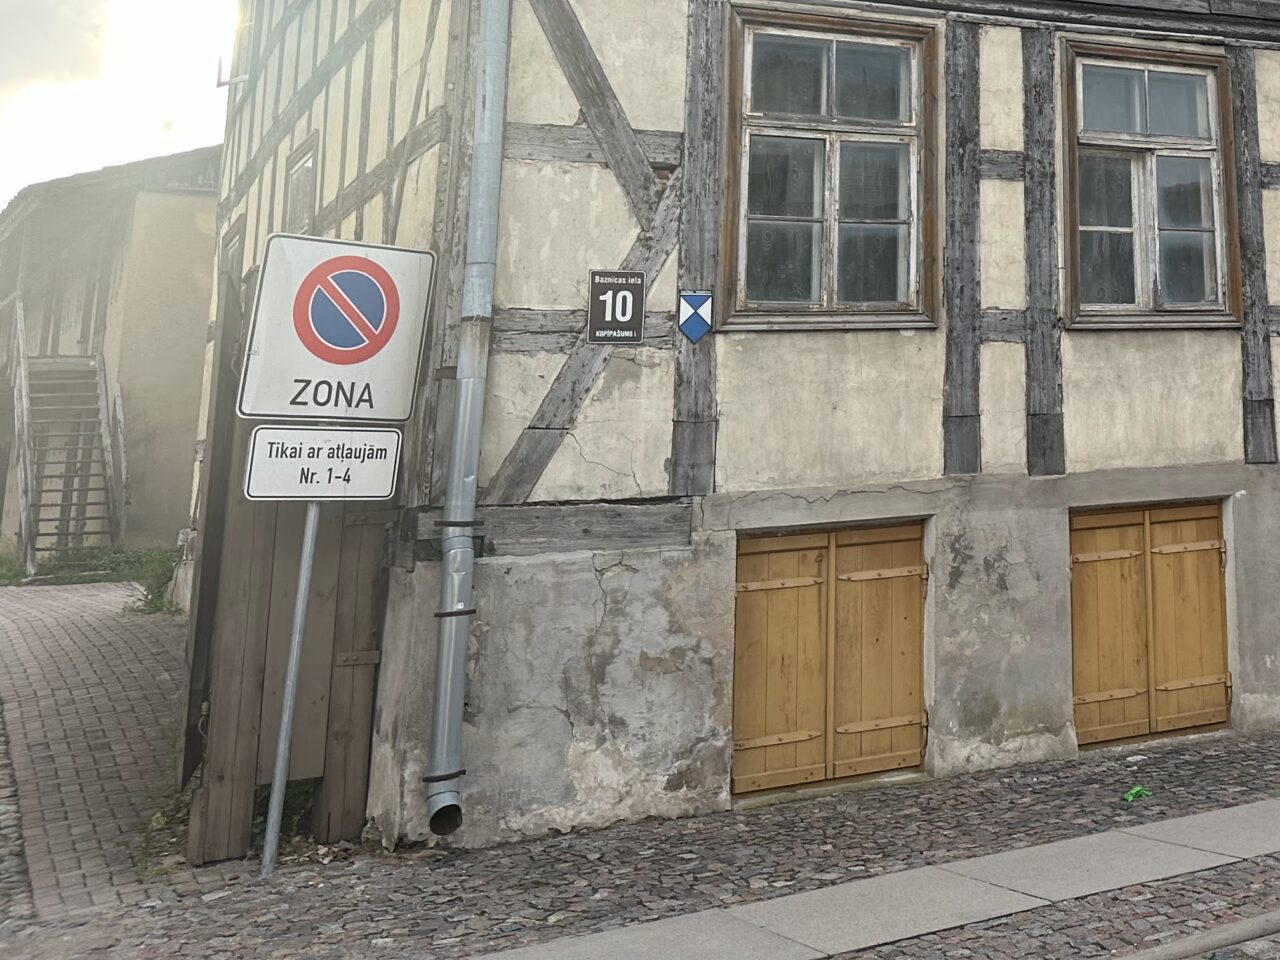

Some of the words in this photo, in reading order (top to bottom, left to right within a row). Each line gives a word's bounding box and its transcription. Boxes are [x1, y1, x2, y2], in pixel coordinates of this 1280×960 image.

[628, 276, 642, 285] iela
[599, 290, 634, 322] 10
[289, 378, 374, 409] ZONA
[267, 442, 303, 459] Tikai
[307, 446, 324, 459] ar
[327, 443, 388, 463] atļaujām
[299, 467, 320, 484] Nr.
[327, 468, 351, 484] 1-4
